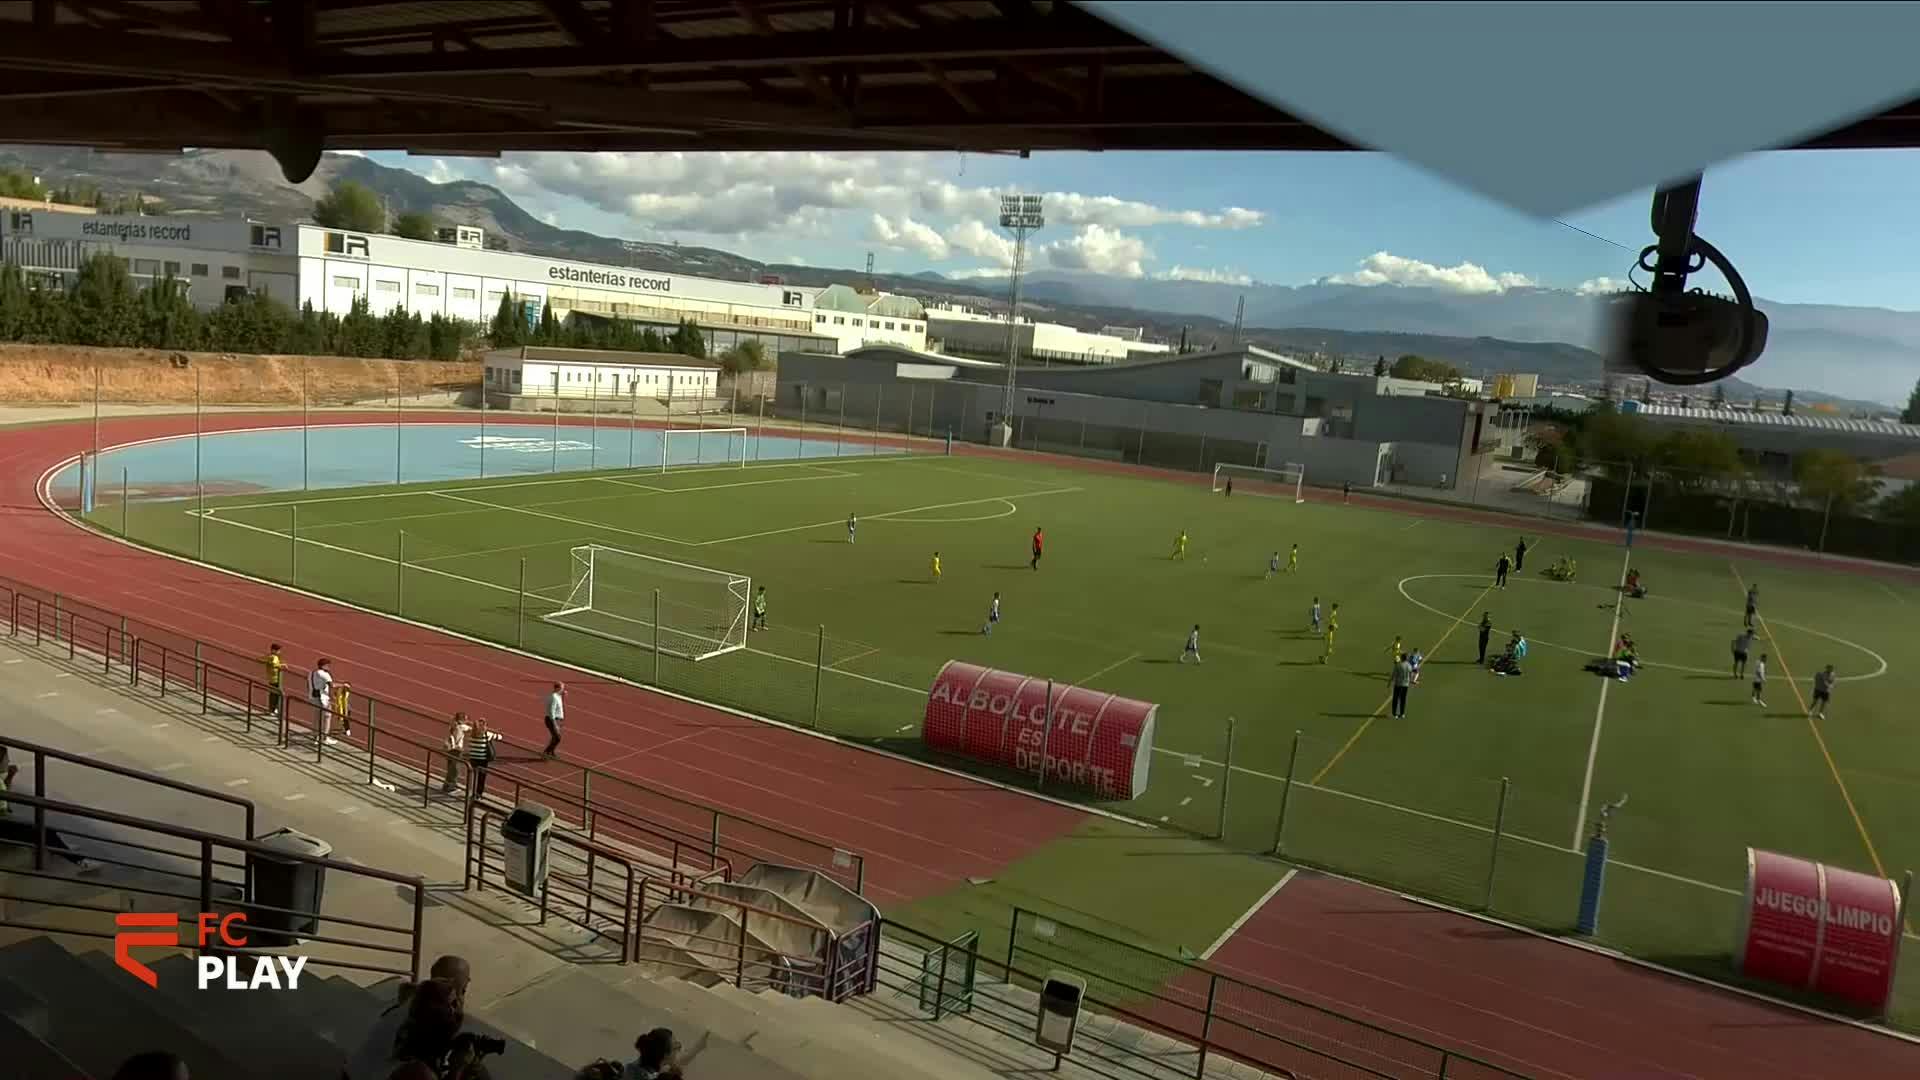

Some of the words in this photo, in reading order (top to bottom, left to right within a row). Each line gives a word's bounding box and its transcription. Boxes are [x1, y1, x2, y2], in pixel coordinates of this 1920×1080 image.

[149, 224, 190, 240] record
[629, 276, 671, 291] record
[931, 680, 1092, 735] ALBOLOTE
[1018, 727, 1043, 746] ES
[1015, 746, 1115, 793] DEPORTE
[1755, 887, 1819, 921] JUEGO
[1825, 900, 1893, 937] LIMPIO
